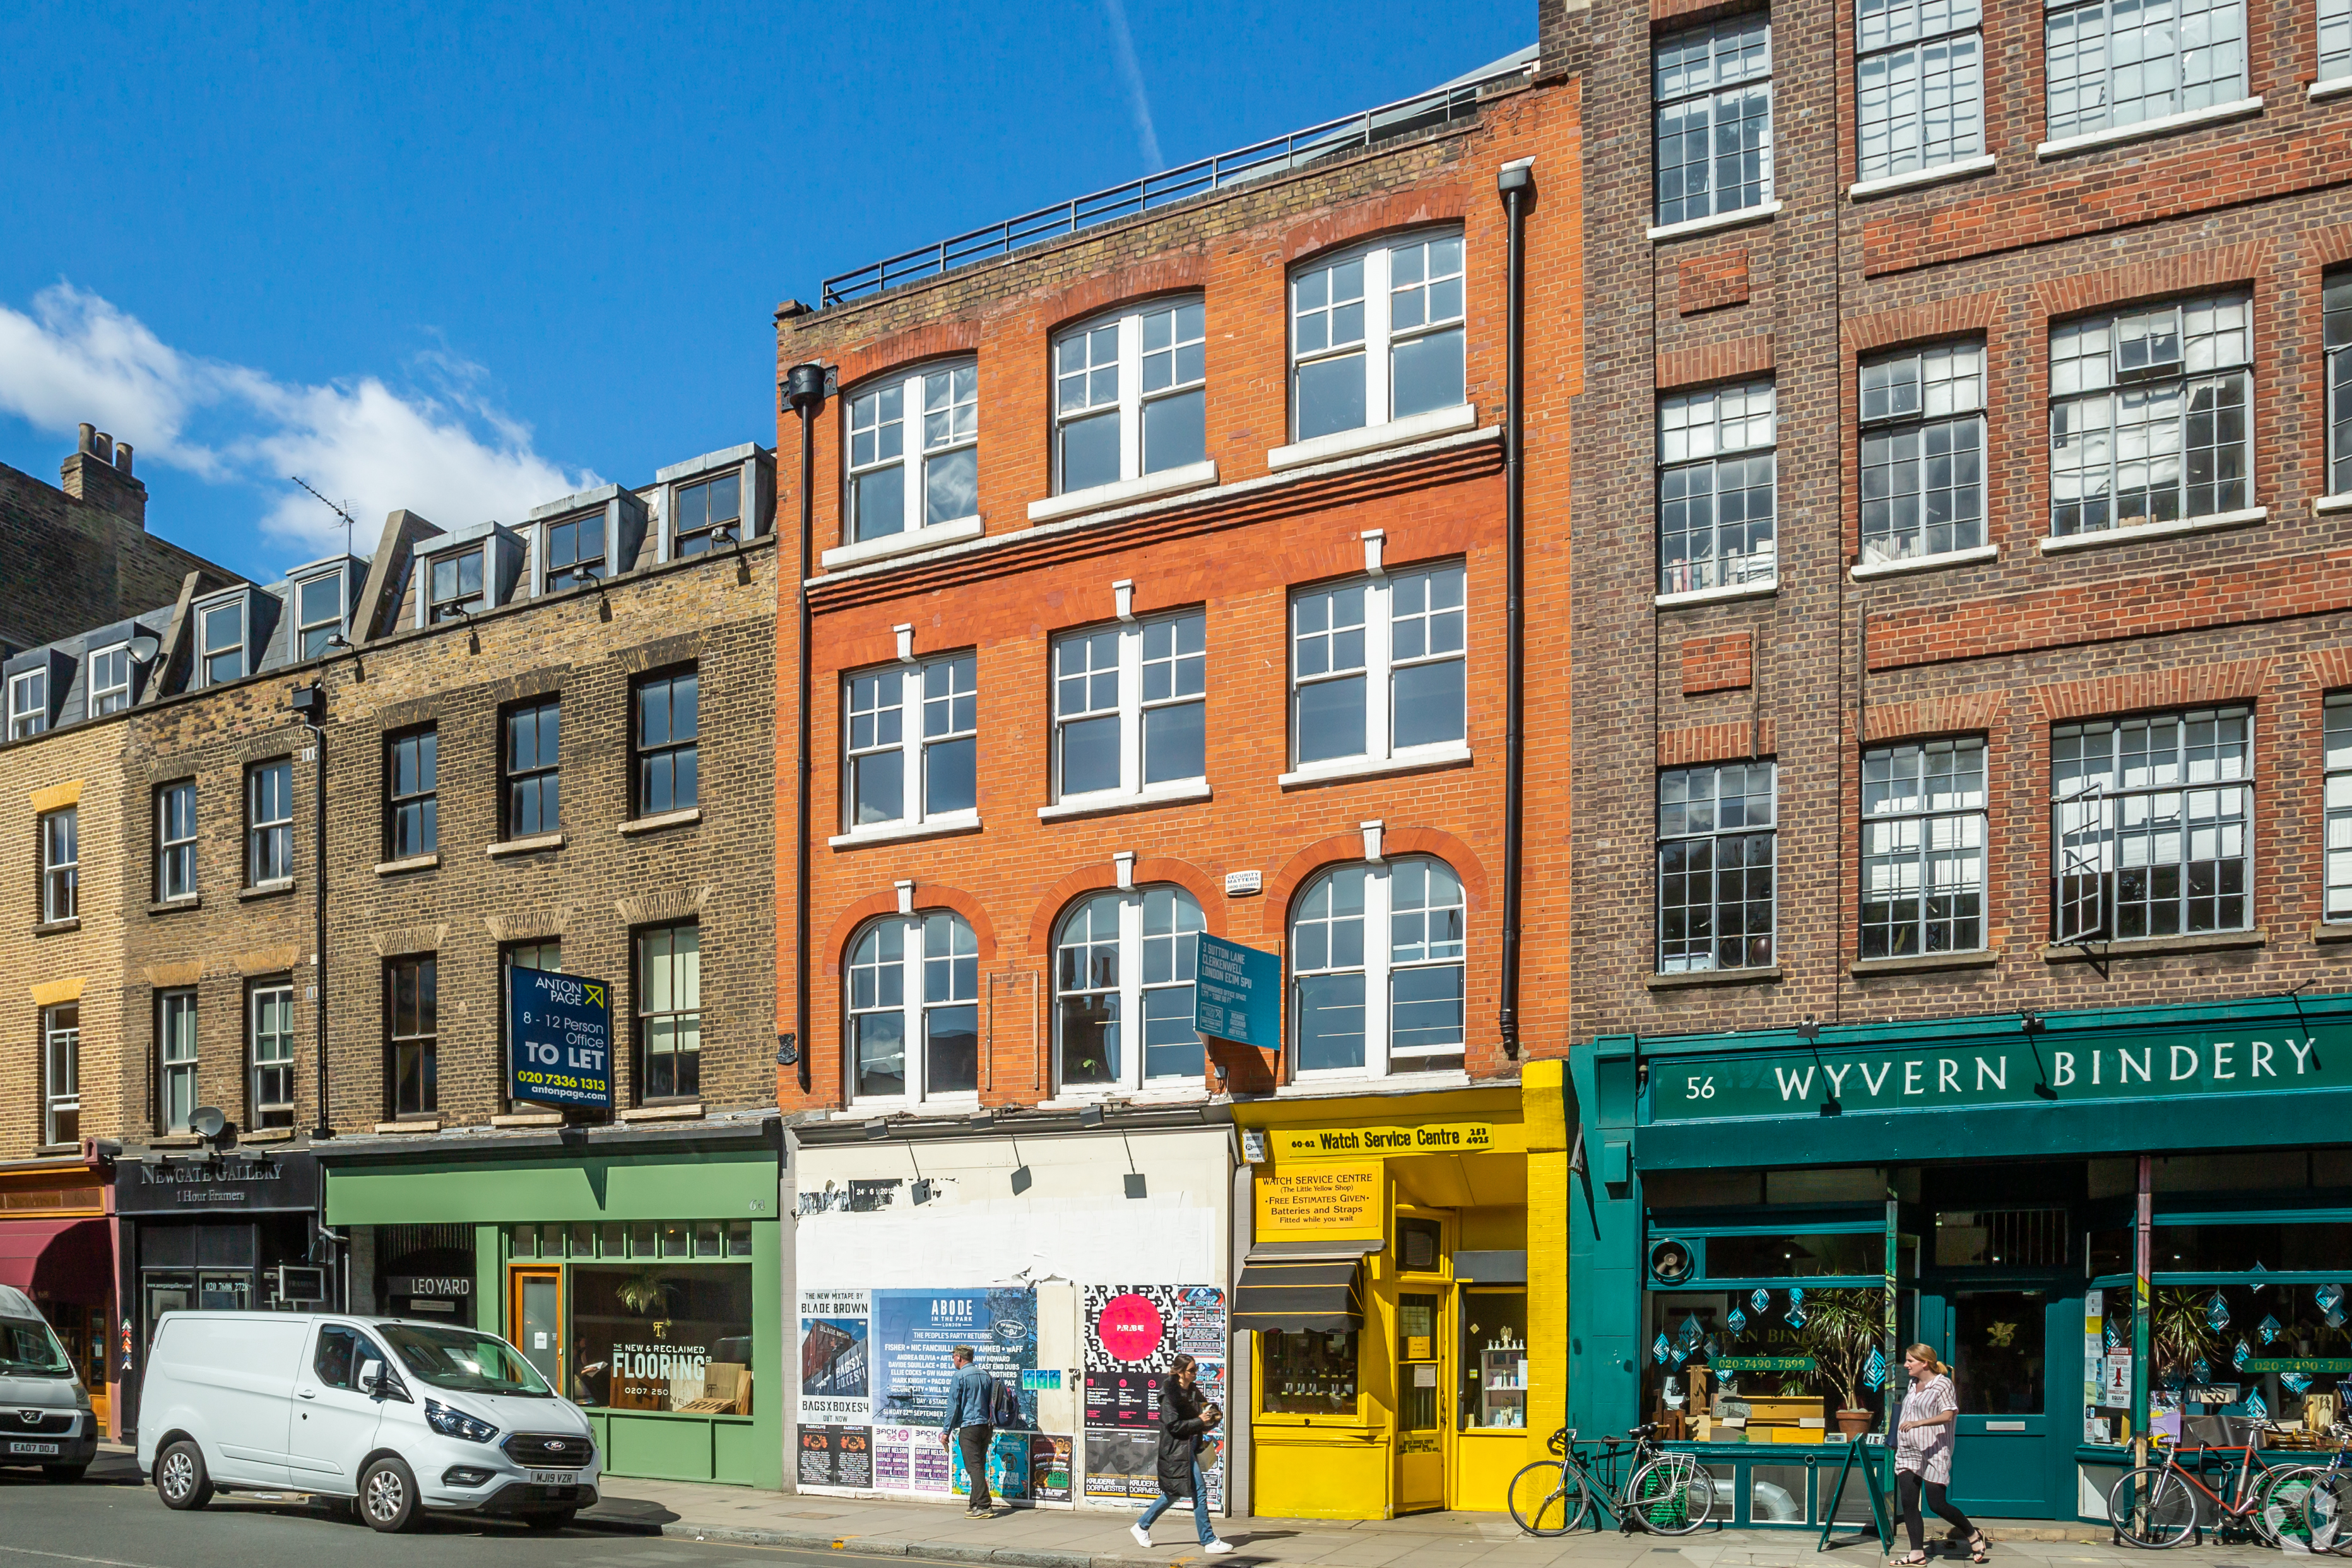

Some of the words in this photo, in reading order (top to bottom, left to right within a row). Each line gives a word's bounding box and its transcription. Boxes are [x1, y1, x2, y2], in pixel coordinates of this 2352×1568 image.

[1203, 942, 1207, 952] 3
[1208, 944, 1229, 960] SUTTON
[1231, 951, 1245, 965] LANE
[1202, 953, 1242, 976] CLERKENWELL
[1202, 965, 1223, 982] LONDON
[535, 977, 581, 994] ANTON
[551, 990, 582, 1006] PAGE
[524, 1011, 531, 1023] 8
[545, 1015, 560, 1029] 12
[564, 1017, 603, 1034] Person
[566, 1032, 604, 1048] Office
[525, 1041, 559, 1065] TO
[569, 1047, 605, 1070] LET
[1686, 1076, 1715, 1099] 56
[1775, 1056, 2006, 1100] WYVERN
[2054, 1038, 2316, 1087] BINDERY
[517, 1070, 543, 1084] 020
[545, 1074, 577, 1088] 7336
[581, 1078, 605, 1091] 1313
[531, 1085, 606, 1100] antonpage.com
[1291, 1140, 1315, 1148] 60-62
[1320, 1133, 1359, 1150] Watch
[1364, 1131, 1411, 1148] Service
[1416, 1128, 1460, 1146] Centre
[1466, 1136, 1489, 1145] 4925
[141, 1165, 211, 1185] NEWGATE
[216, 1162, 284, 1182] GALLERY
[1262, 1176, 1292, 1186] WATCH
[1296, 1176, 1333, 1185] SERVICE
[1337, 1174, 1373, 1183] CENTRE
[177, 1191, 182, 1202] 1
[183, 1190, 206, 1202] Hour
[208, 1190, 245, 1201] Framers
[1334, 1184, 1353, 1193] Shop)
[748, 1199, 765, 1211] 64
[1268, 1196, 1291, 1205] FREE
[1292, 1195, 1337, 1204] ESTIMATES
[1340, 1194, 1366, 1203] GIVEN
[1271, 1206, 1310, 1215] Batteries
[1313, 1205, 1330, 1214] and
[1333, 1205, 1363, 1214] Straps
[206, 1282, 216, 1291] 020
[218, 1282, 232, 1291] 7608
[235, 1282, 249, 1291] 2728
[412, 1278, 434, 1294] LEO
[435, 1278, 470, 1295] YARD
[801, 1304, 830, 1313] BLADE
[834, 1304, 868, 1314] BROWN
[931, 1300, 973, 1316] ABODE
[654, 1345, 706, 1354] RECLAIMED
[613, 1352, 706, 1381] FLOORING
[1719, 1359, 1739, 1368] 020
[1744, 1359, 1771, 1368] 7490
[1778, 1359, 1805, 1368] 7899
[2254, 1362, 2279, 1371] 020
[2286, 1361, 2318, 1371] 7490
[536, 1473, 555, 1483] MJ19
[558, 1474, 572, 1483] VZR
